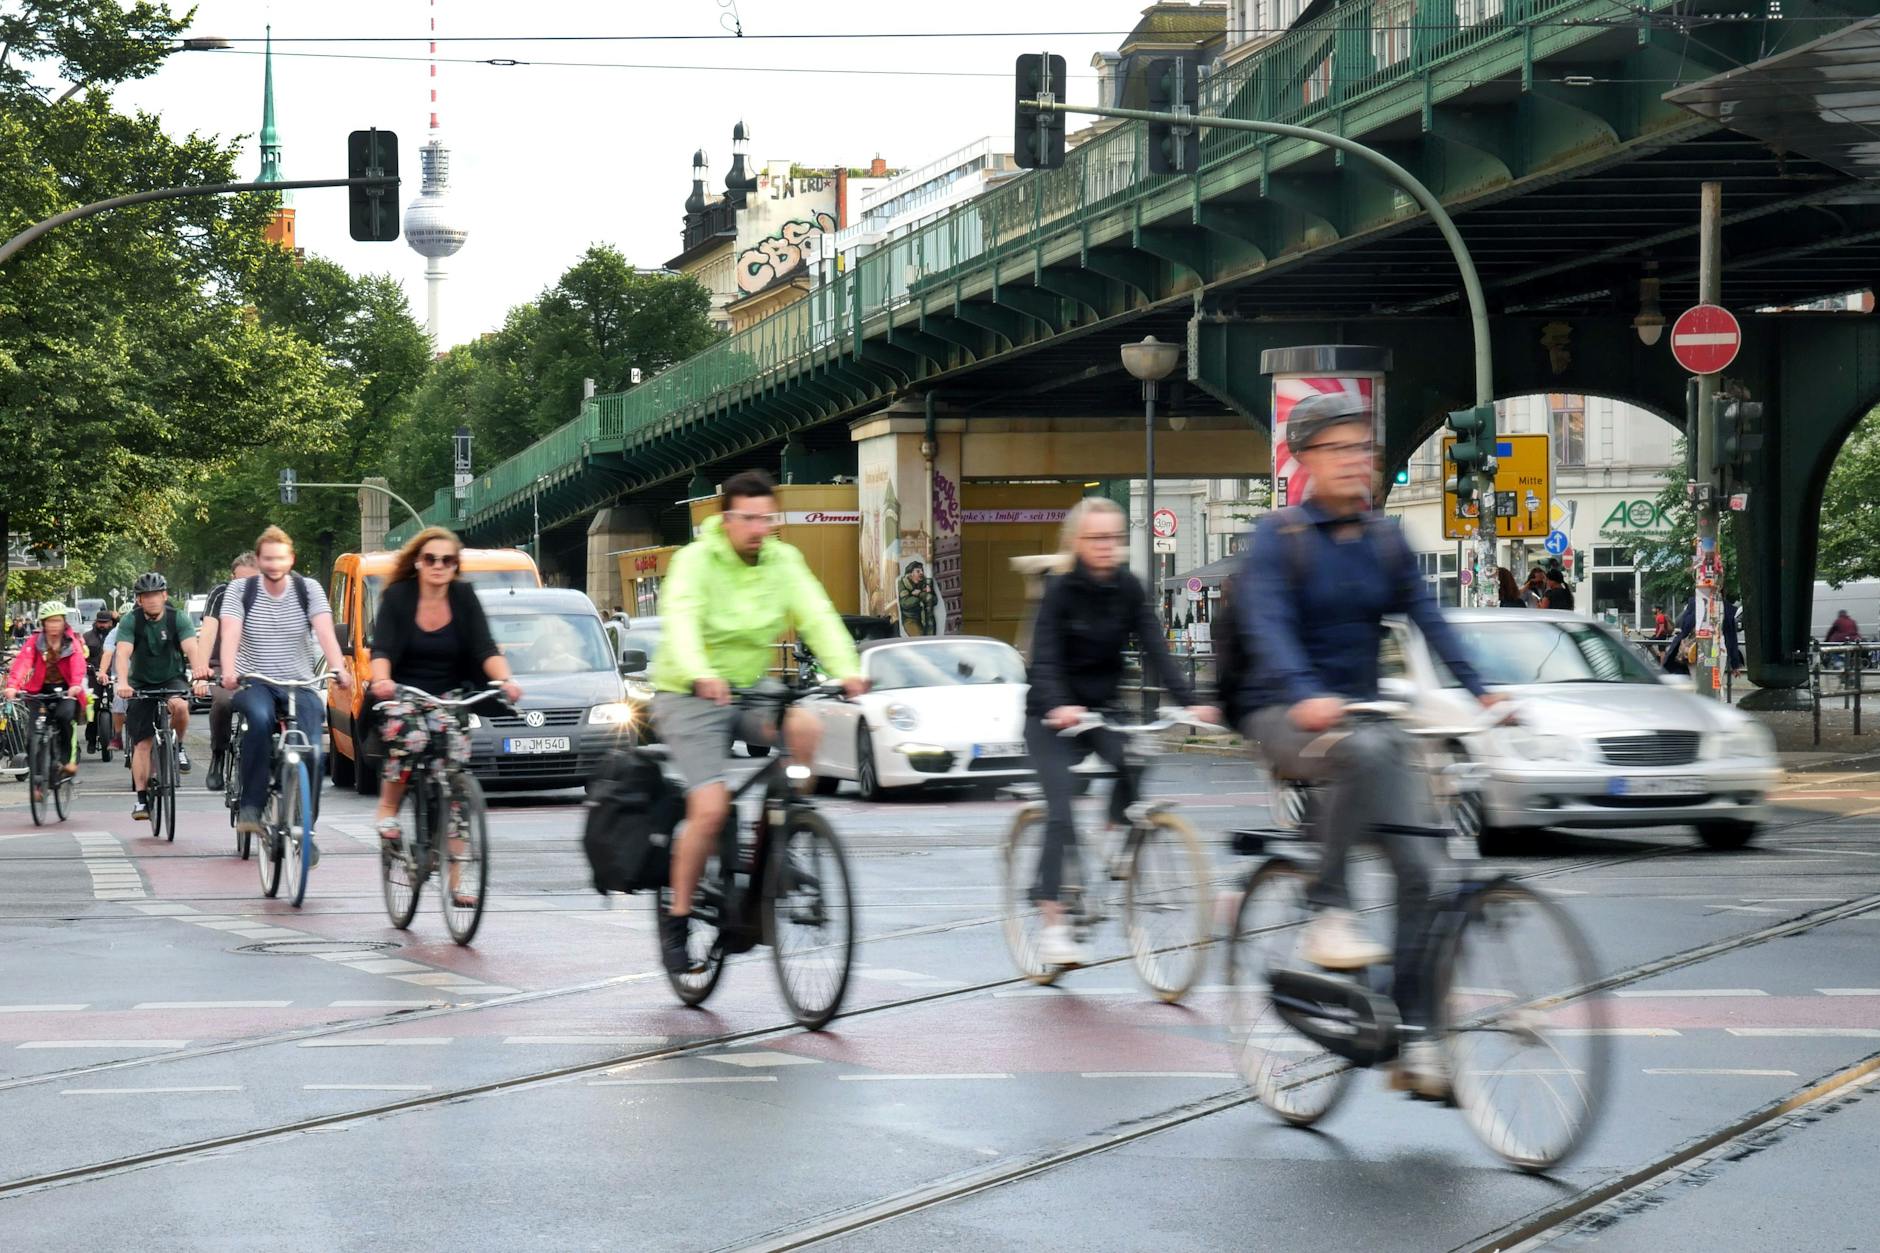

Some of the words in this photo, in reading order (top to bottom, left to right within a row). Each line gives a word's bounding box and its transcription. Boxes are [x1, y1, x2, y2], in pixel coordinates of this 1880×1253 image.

[1519, 477, 1543, 485] Mitte
[1601, 500, 1676, 528] AOK
[515, 740, 521, 750] P
[545, 739, 564, 749] 540
